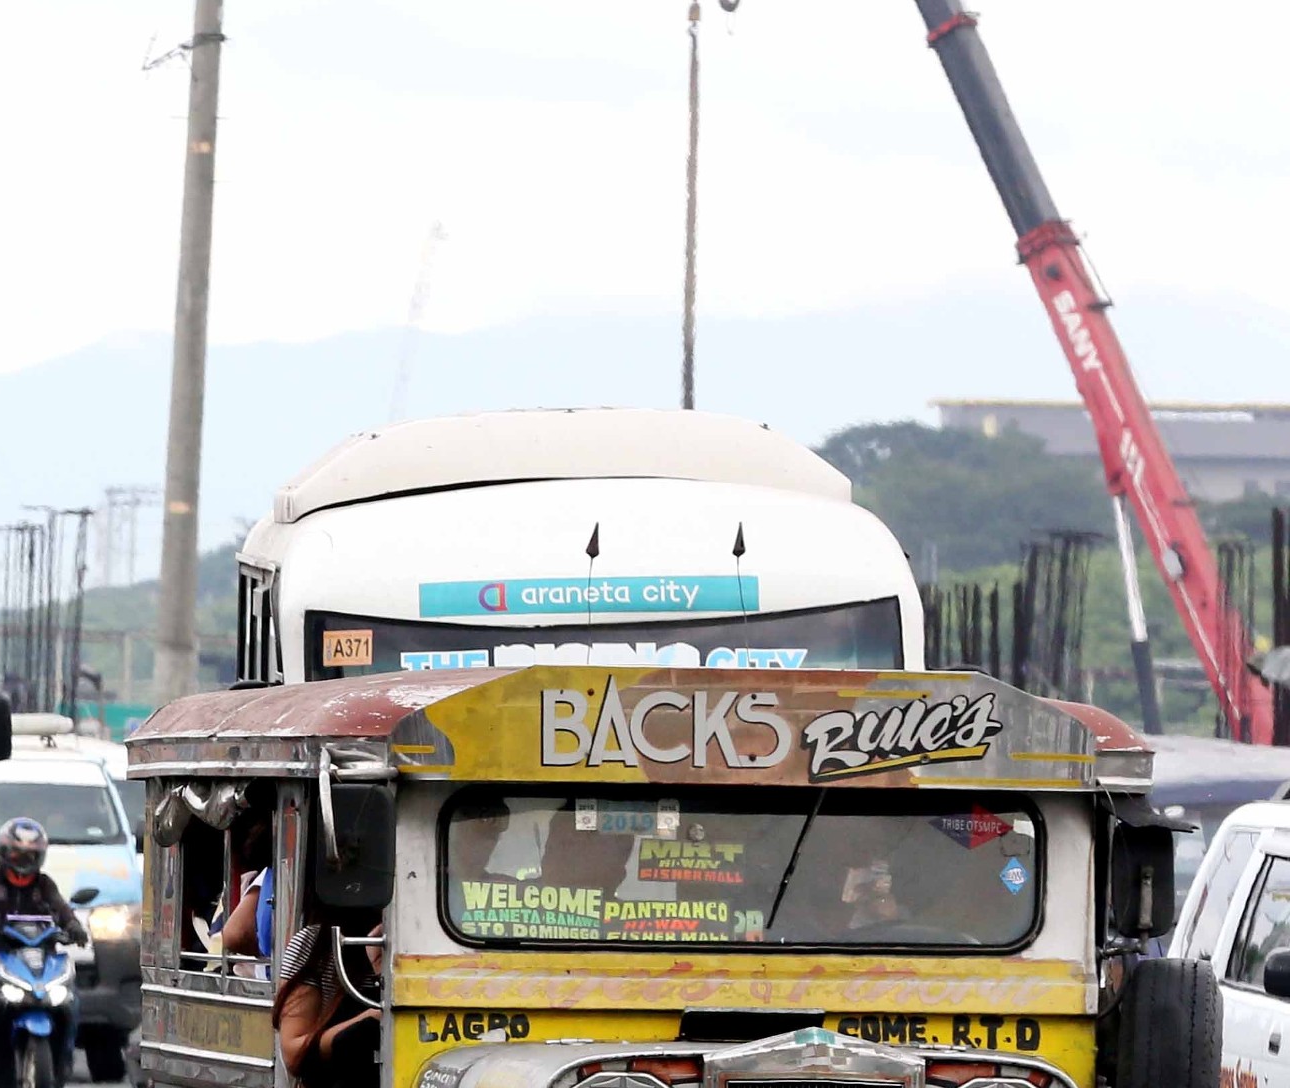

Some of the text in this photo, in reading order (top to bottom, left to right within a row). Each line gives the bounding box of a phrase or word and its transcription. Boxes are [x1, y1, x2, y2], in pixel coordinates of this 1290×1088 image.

[1052, 290, 1102, 372] SANY
[520, 578, 700, 609] araneta city
[333, 638, 370, 659] A371
[540, 675, 792, 769] BACKS
[942, 818, 965, 831] TRIBE
[639, 840, 744, 863] MRT
[461, 881, 603, 919] WELCOME
[461, 908, 541, 925] ARANETA
[603, 901, 729, 923] PANTRANCO
